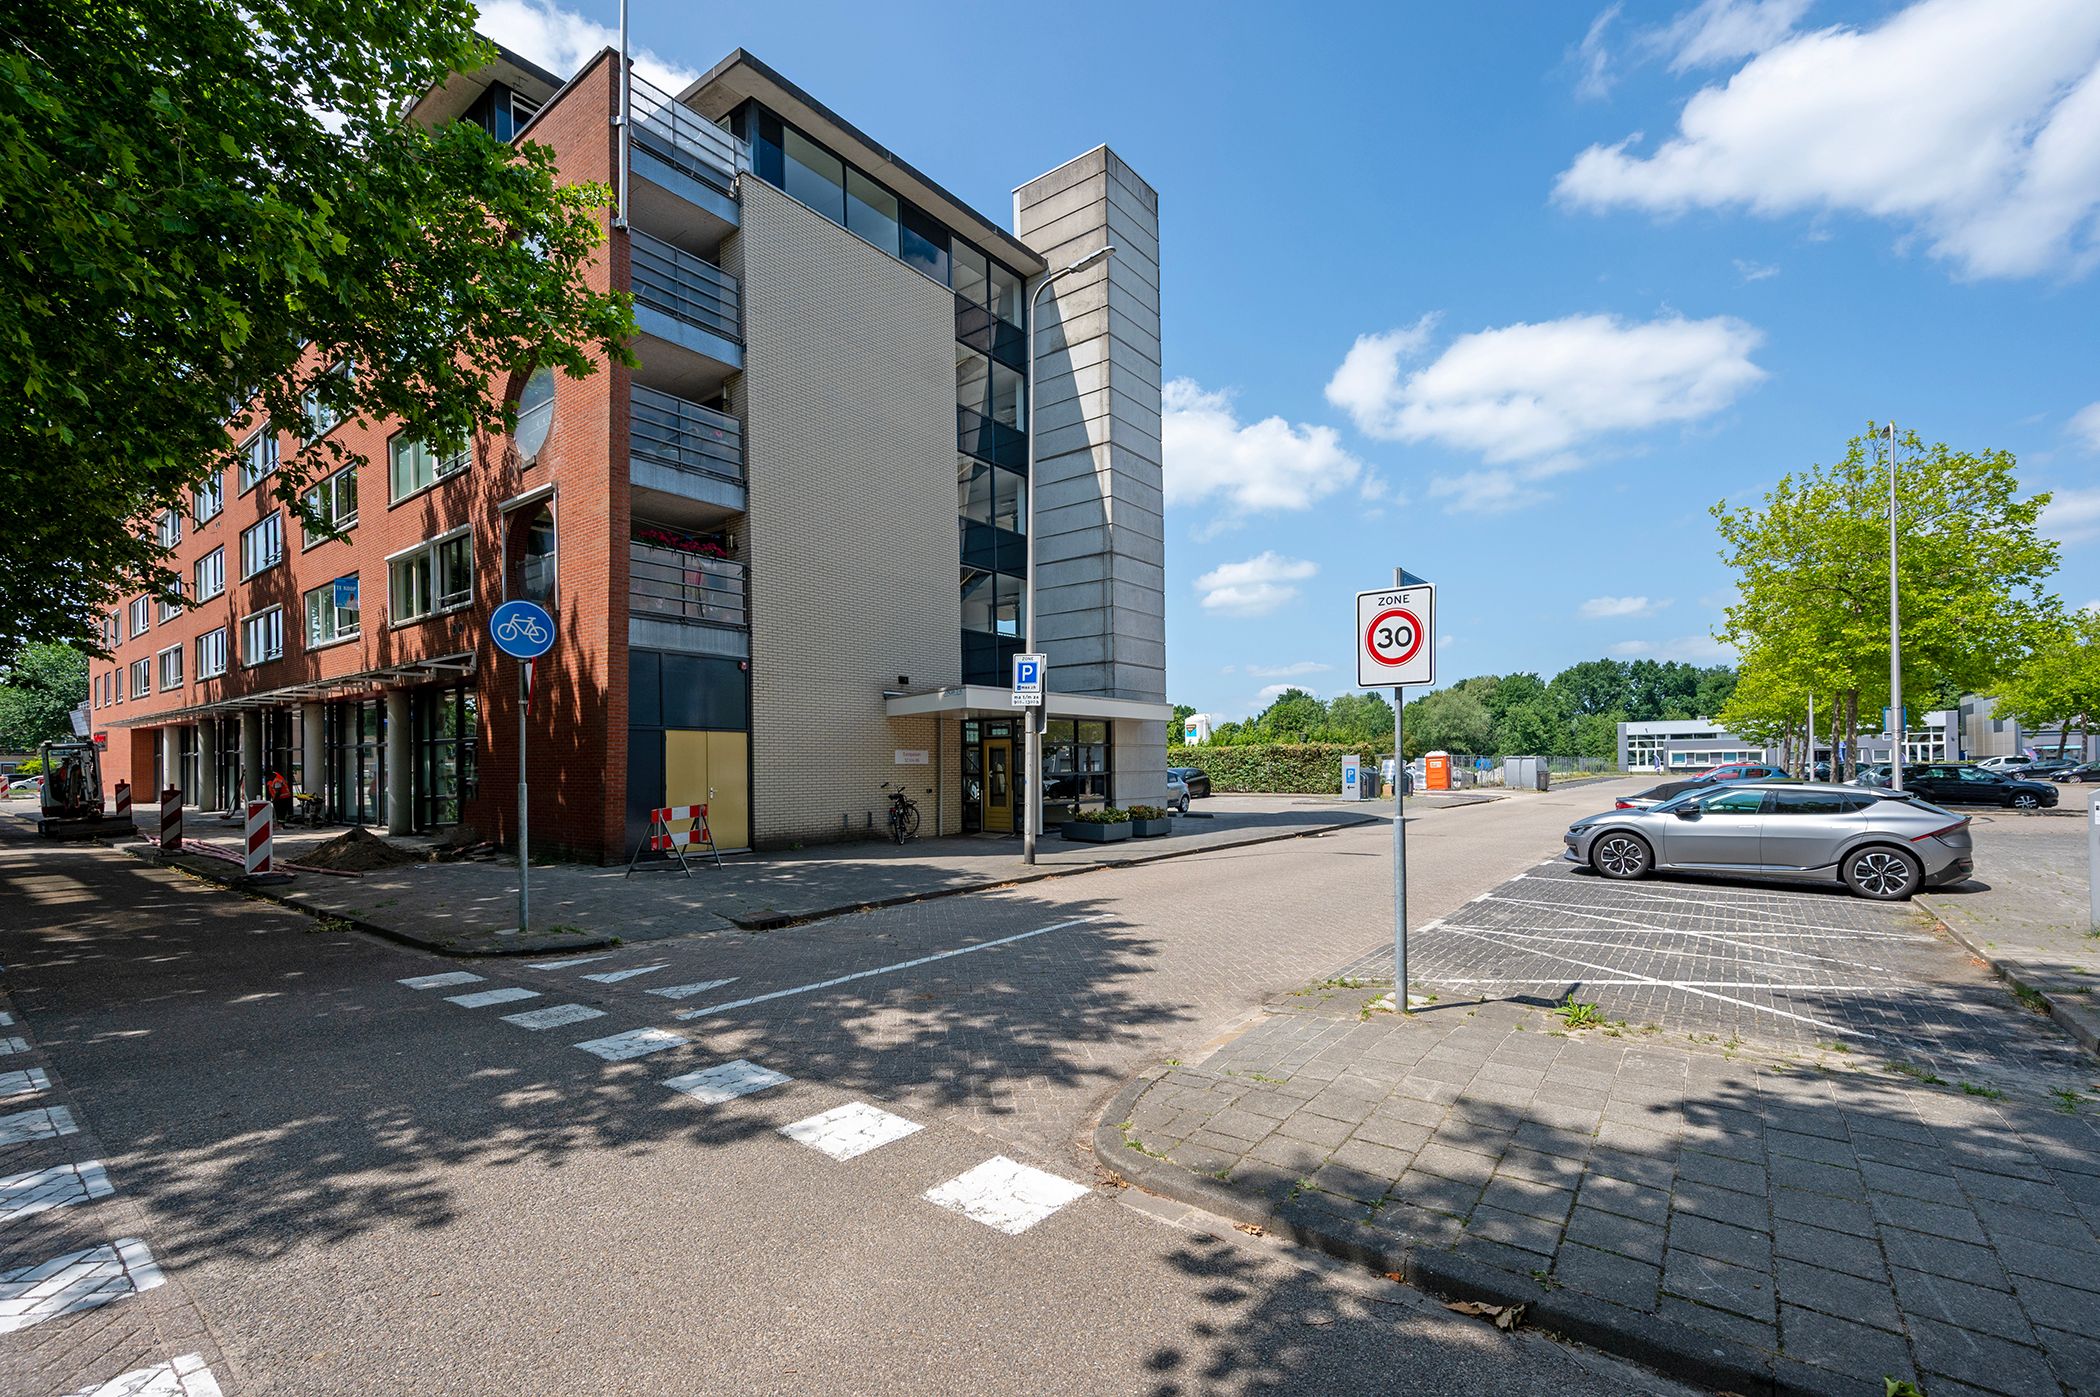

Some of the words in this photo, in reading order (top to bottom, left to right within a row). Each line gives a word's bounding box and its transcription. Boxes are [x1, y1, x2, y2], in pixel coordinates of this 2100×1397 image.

[1378, 594, 1410, 606] ZONE
[1377, 626, 1412, 648] 30
[1022, 664, 1033, 682] P
[1347, 769, 1354, 778] P
